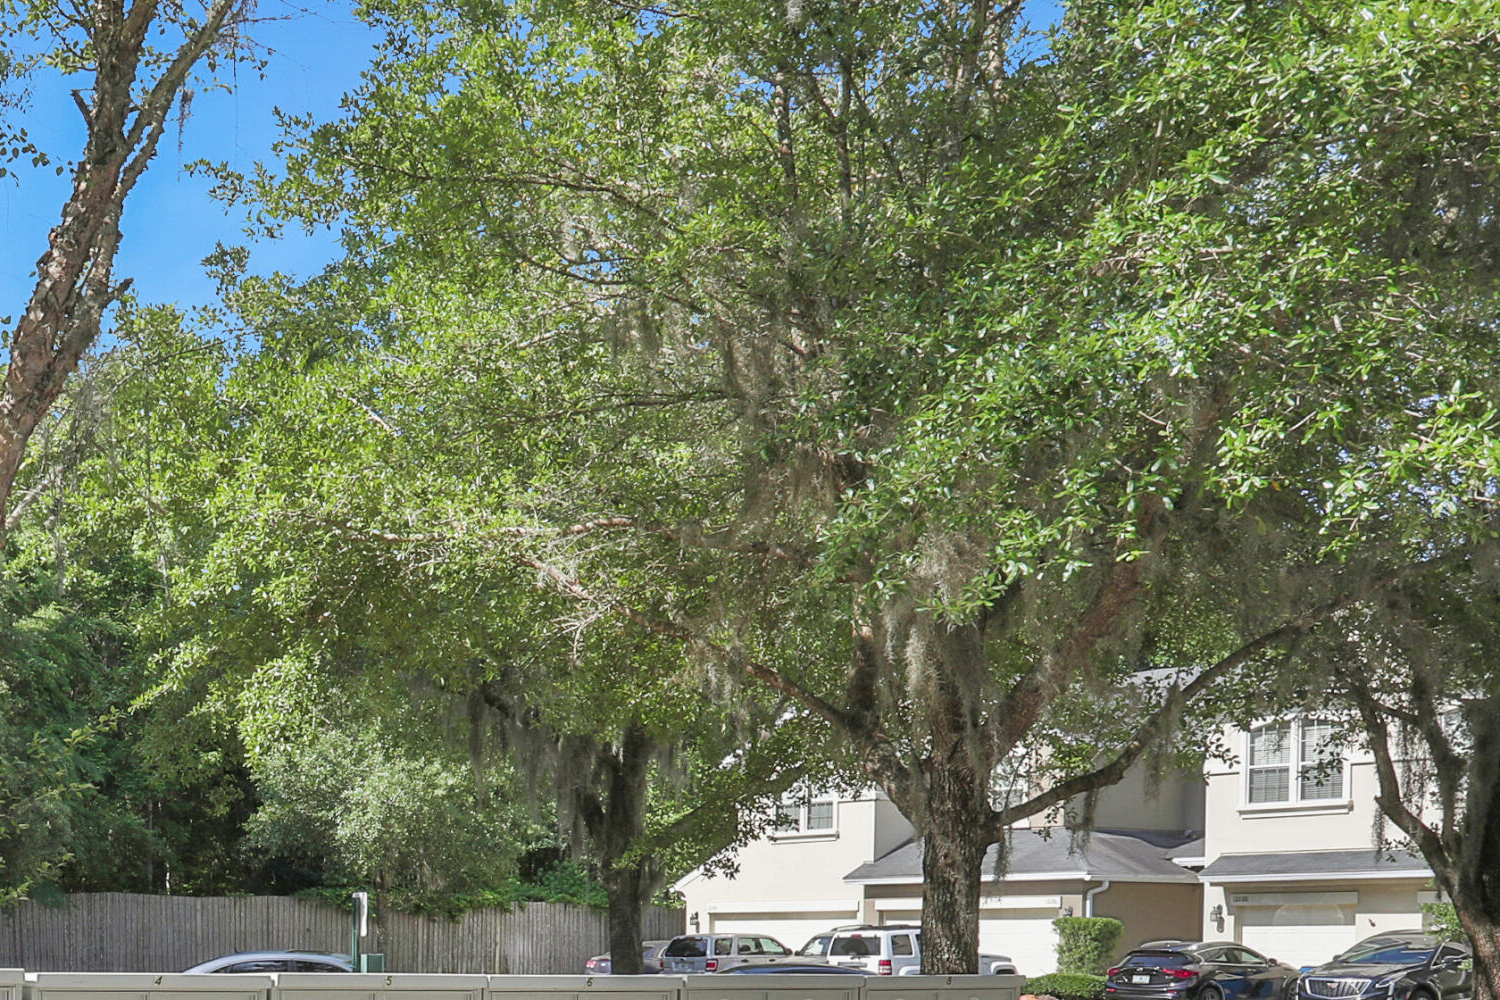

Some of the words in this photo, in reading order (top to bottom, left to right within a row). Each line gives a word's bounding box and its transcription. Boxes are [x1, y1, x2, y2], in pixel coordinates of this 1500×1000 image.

[155, 977, 163, 986] 4
[386, 976, 393, 986] 5
[587, 978, 593, 987] 6
